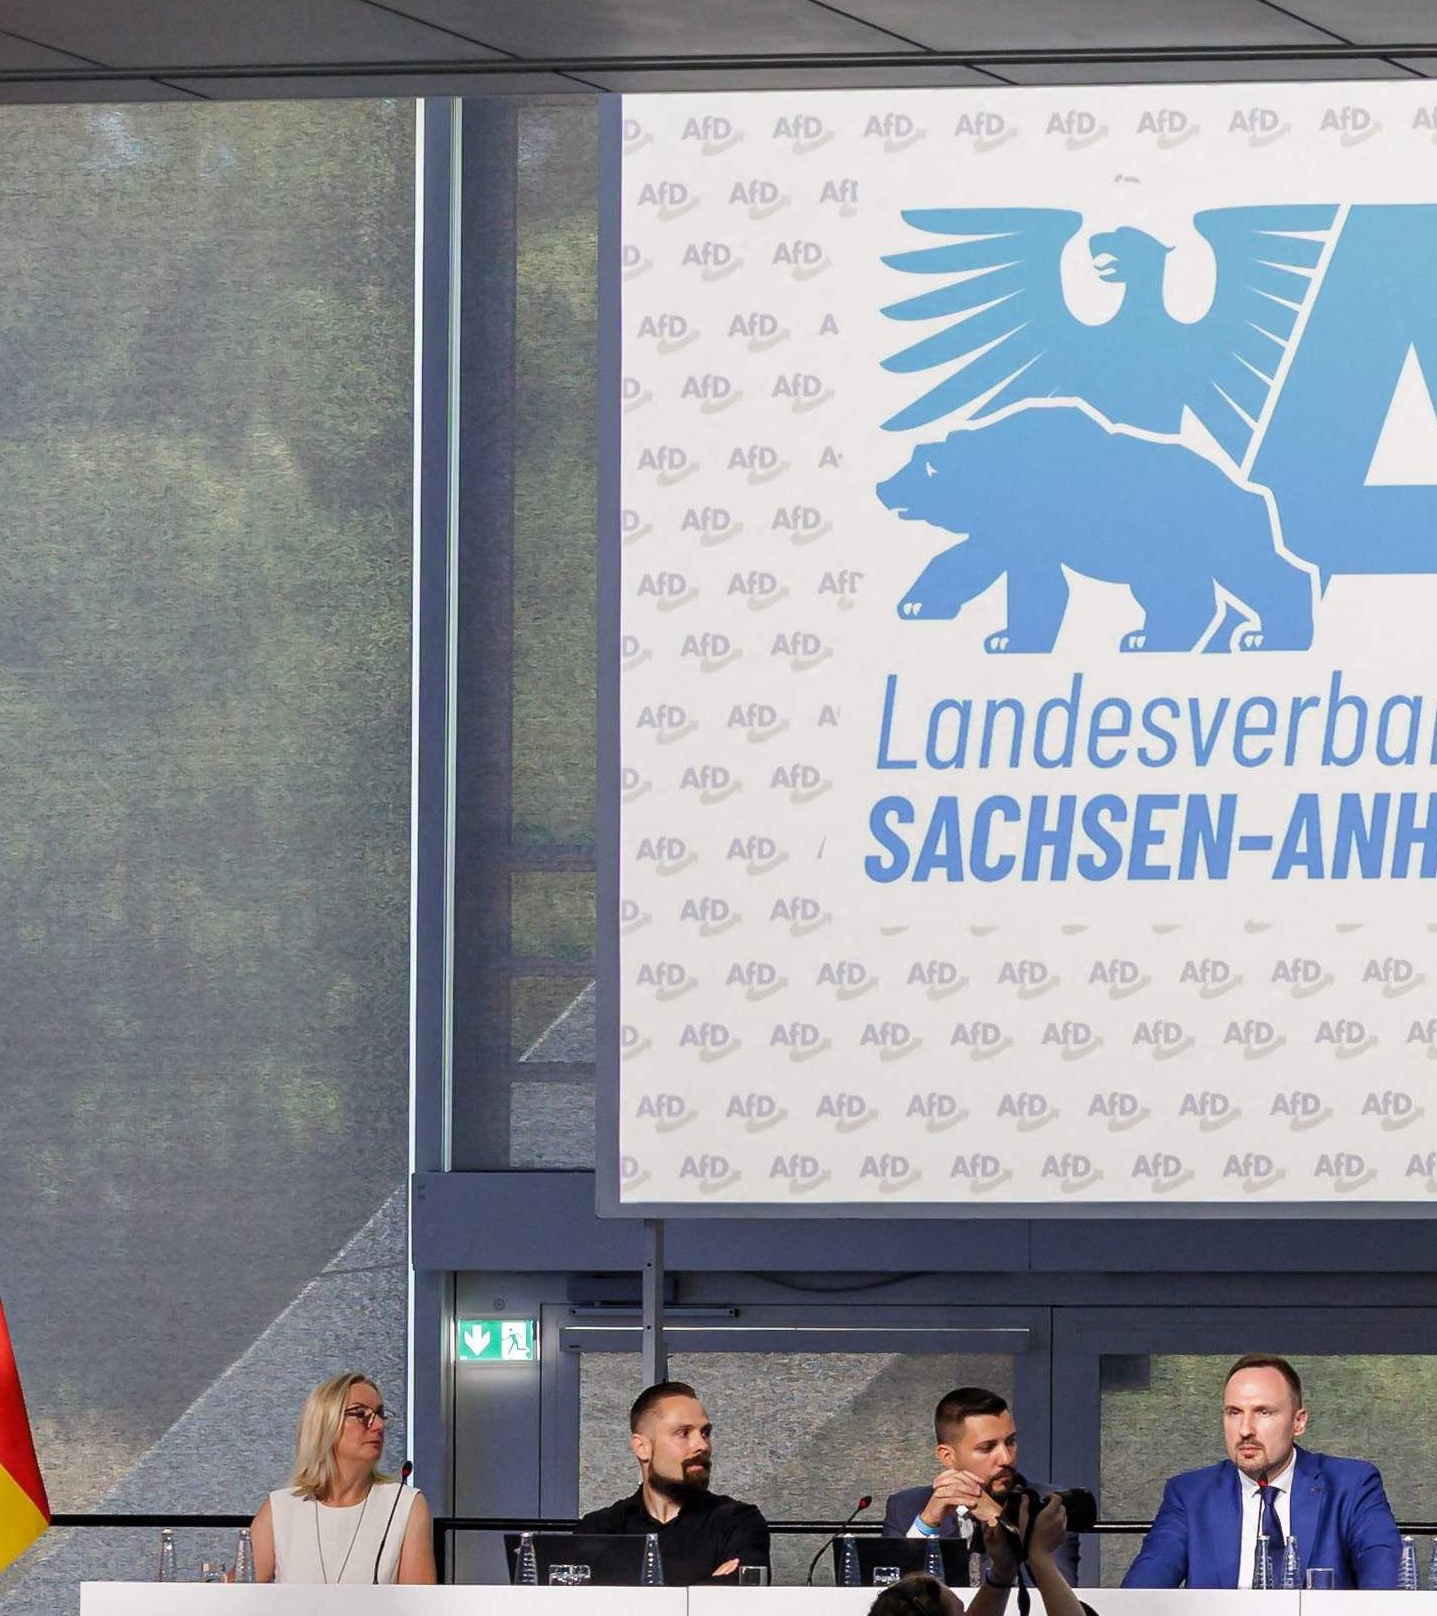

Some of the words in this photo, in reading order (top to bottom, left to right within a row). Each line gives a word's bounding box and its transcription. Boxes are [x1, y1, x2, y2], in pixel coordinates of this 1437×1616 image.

[682, 116, 731, 140] AfD
[864, 113, 913, 137] AfD
[955, 112, 1004, 136] AfD
[1046, 111, 1095, 135] AfD
[1229, 108, 1278, 132] AfD
[1320, 107, 1369, 131] AfD
[638, 181, 687, 205] AfD
[729, 180, 778, 204] AfD
[682, 242, 731, 266] AfD
[772, 241, 821, 265] AfD
[638, 314, 687, 338] AfD
[681, 374, 730, 398] AfD
[772, 373, 821, 397] AfD
[637, 446, 686, 470] AfD
[728, 445, 777, 469] AfD
[681, 507, 730, 531] AfD
[771, 506, 820, 530] AfD
[727, 571, 776, 595] AfD
[680, 633, 729, 657] AfD
[637, 704, 686, 728] AfD
[727, 704, 776, 728] AfD
[680, 765, 729, 789] AfD
[770, 764, 819, 788] AfD
[636, 837, 685, 861] AfD
[727, 836, 776, 860] AfD
[680, 897, 729, 921] AfD
[770, 897, 819, 921] AfD
[636, 962, 685, 986] AfD
[817, 961, 866, 985] AfD
[907, 961, 956, 985] AfD
[998, 960, 1047, 984] AfD
[1089, 959, 1138, 983] AfD
[1272, 958, 1321, 982] AfD
[1363, 958, 1412, 982] AfD
[680, 1023, 729, 1047] AfD
[770, 1022, 819, 1046] AfD
[860, 1022, 909, 1046] AfD
[1042, 1021, 1091, 1045] AfD
[1133, 1020, 1182, 1044] AfD
[1224, 1020, 1273, 1044] AfD
[636, 1094, 685, 1118] AfD
[816, 1093, 865, 1117] AfD
[907, 1093, 956, 1117] AfD
[997, 1093, 1046, 1117] AfD
[1088, 1092, 1137, 1116] AfD
[1271, 1091, 1320, 1115] AfD
[1362, 1091, 1411, 1115] AfD
[679, 1154, 728, 1178] AfD
[769, 1154, 818, 1178] AfD
[950, 1154, 999, 1178] AfD
[1041, 1154, 1090, 1178] AfD
[1132, 1153, 1181, 1177] AfD
[1315, 1153, 1364, 1177] AfD
